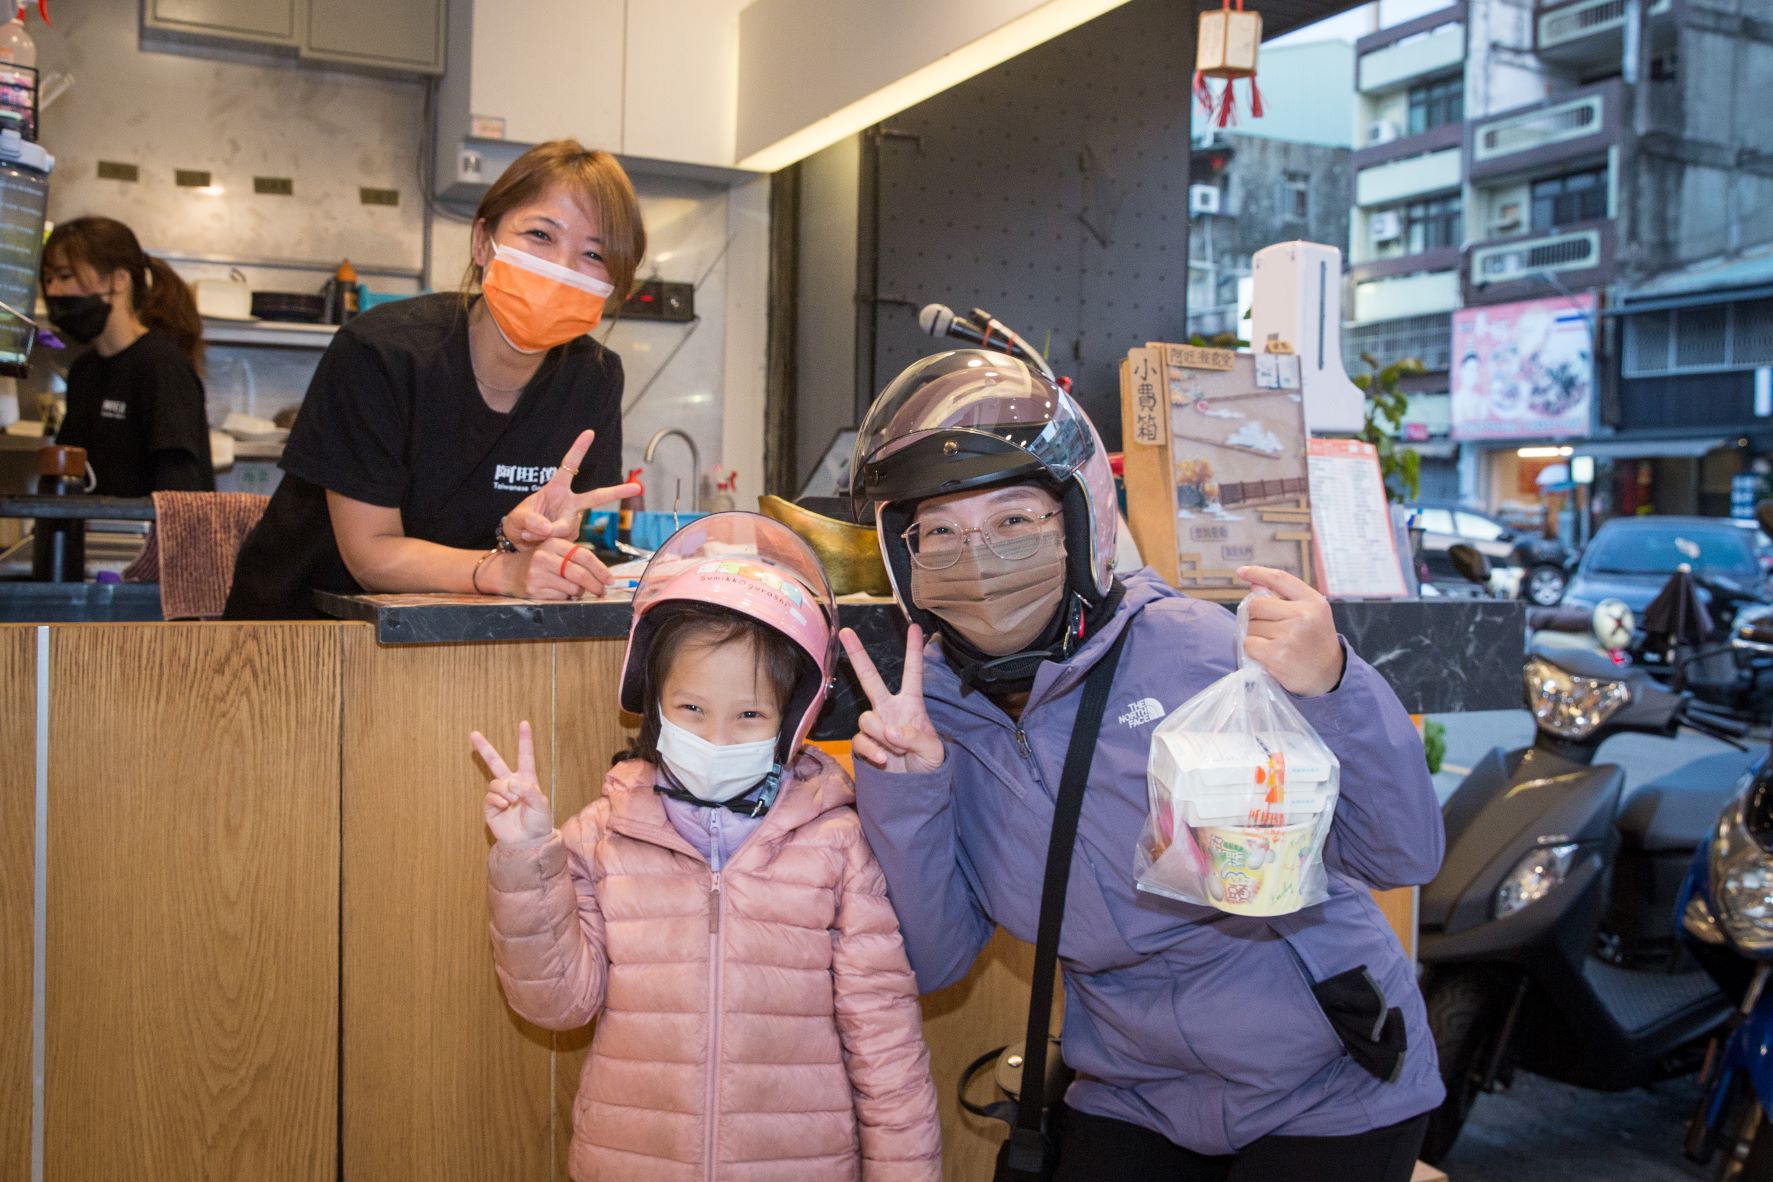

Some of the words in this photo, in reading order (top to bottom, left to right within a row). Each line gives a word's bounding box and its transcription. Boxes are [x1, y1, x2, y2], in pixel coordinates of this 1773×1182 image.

[1133, 357, 1158, 441] 小費箱
[493, 481, 530, 492] Taiwanese
[1128, 700, 1146, 712] THE
[1118, 706, 1149, 724] NORTH
[1128, 715, 1150, 729] FACE
